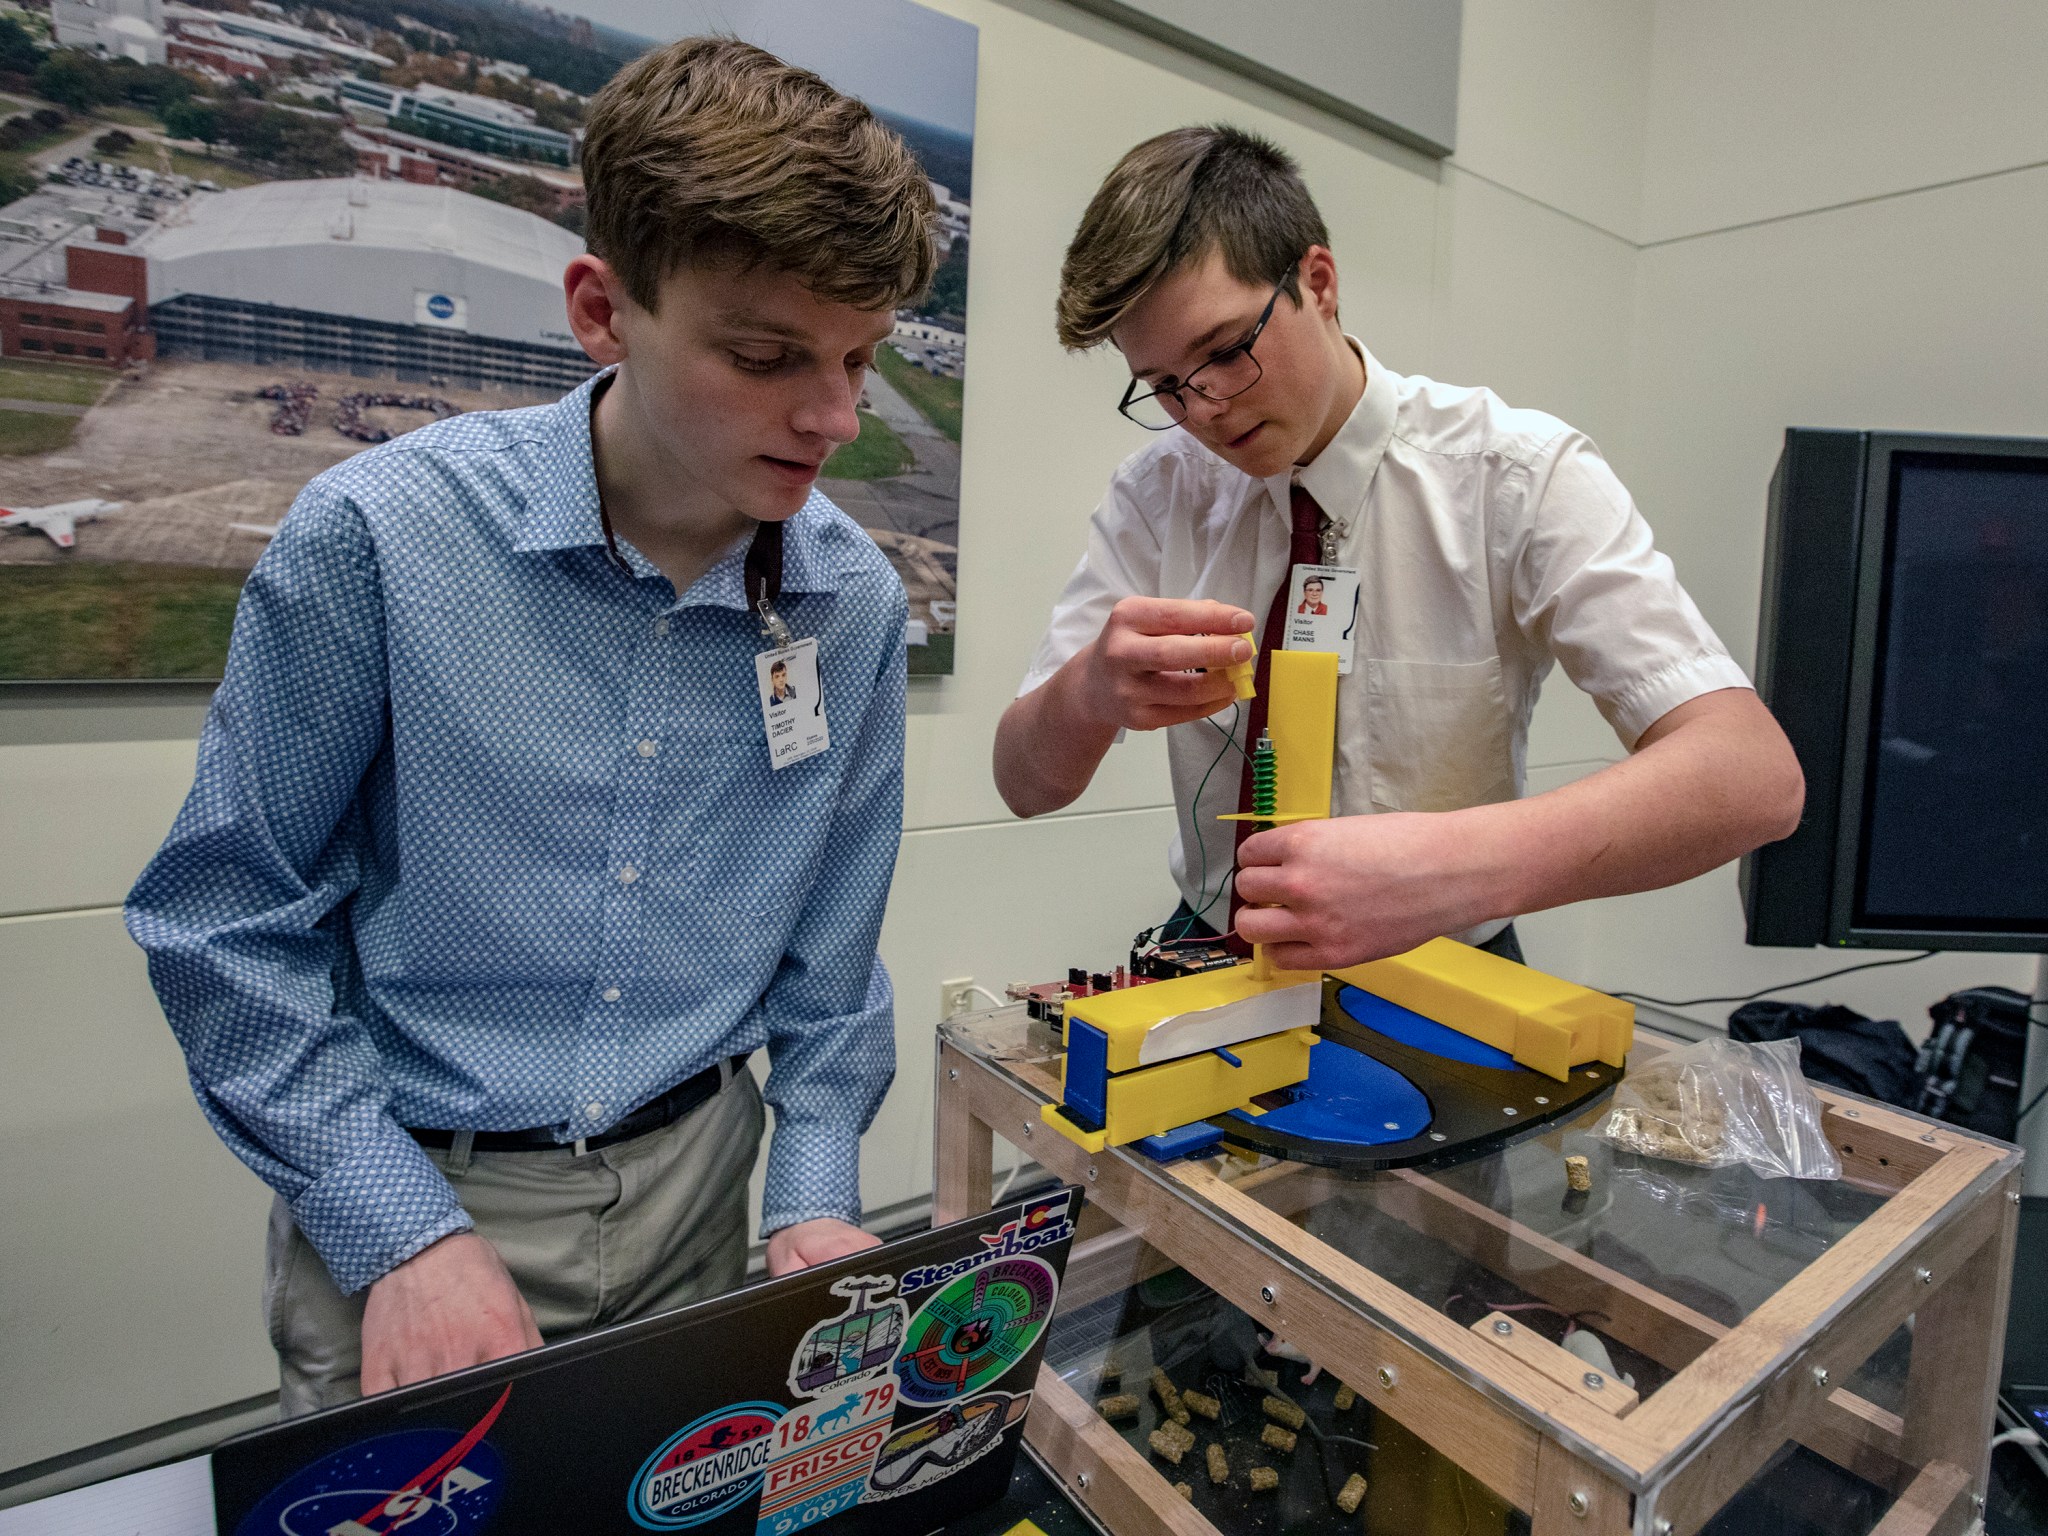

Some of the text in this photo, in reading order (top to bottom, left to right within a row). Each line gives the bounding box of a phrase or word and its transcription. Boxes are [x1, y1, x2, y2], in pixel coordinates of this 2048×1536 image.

[769, 709, 787, 719] Visitor
[771, 718, 795, 731] TIMOTHY
[772, 726, 794, 738] DACIER
[775, 742, 798, 757] LaRC
[900, 1222, 1072, 1294] Steamboat
[991, 1286, 1027, 1312] COLORADO
[993, 1263, 1050, 1308] BRECKENRIDGE
[927, 1301, 964, 1326] ELEVATION
[820, 1371, 871, 1393] Colorado
[779, 1383, 895, 1448] 18 79
[674, 1425, 763, 1465] 18 59
[770, 1432, 883, 1491] FRISCO
[652, 1438, 772, 1507] BRECKENRIDGE
[863, 1437, 1001, 1501] COPPER MOUNTAIN
[671, 1479, 748, 1515] COLORADO
